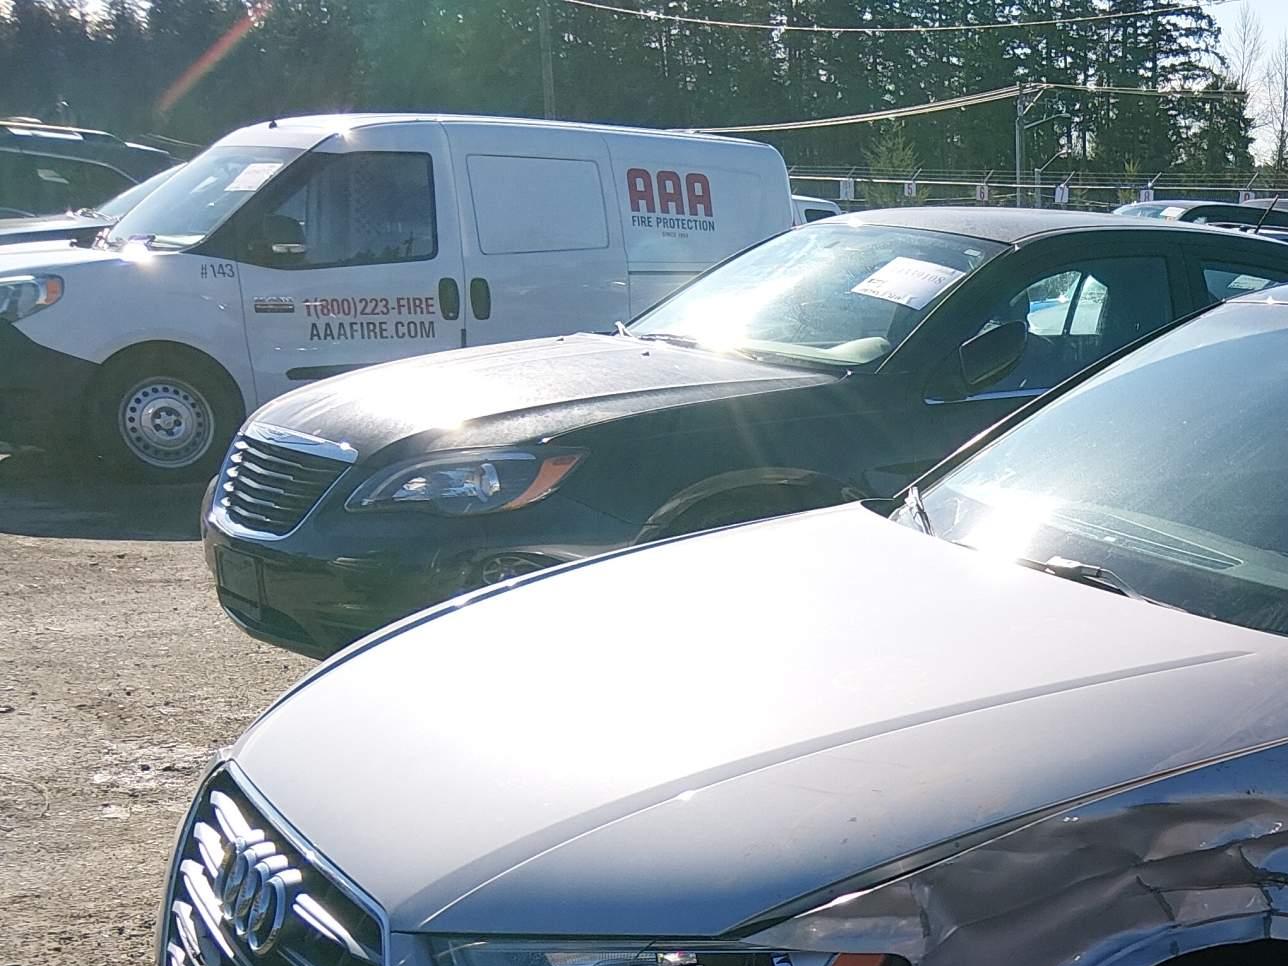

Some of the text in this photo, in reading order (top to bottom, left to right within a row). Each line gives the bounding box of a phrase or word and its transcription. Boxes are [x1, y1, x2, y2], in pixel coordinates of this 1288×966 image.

[626, 167, 713, 217] AAA
[907, 183, 913, 196] 5
[979, 186, 985, 200] 6
[631, 215, 715, 231] FIRE PROTECTION
[200, 263, 235, 279] #143
[303, 296, 436, 319] 1(800)223-FIRE
[310, 320, 436, 341] AAAFIRE.COM
